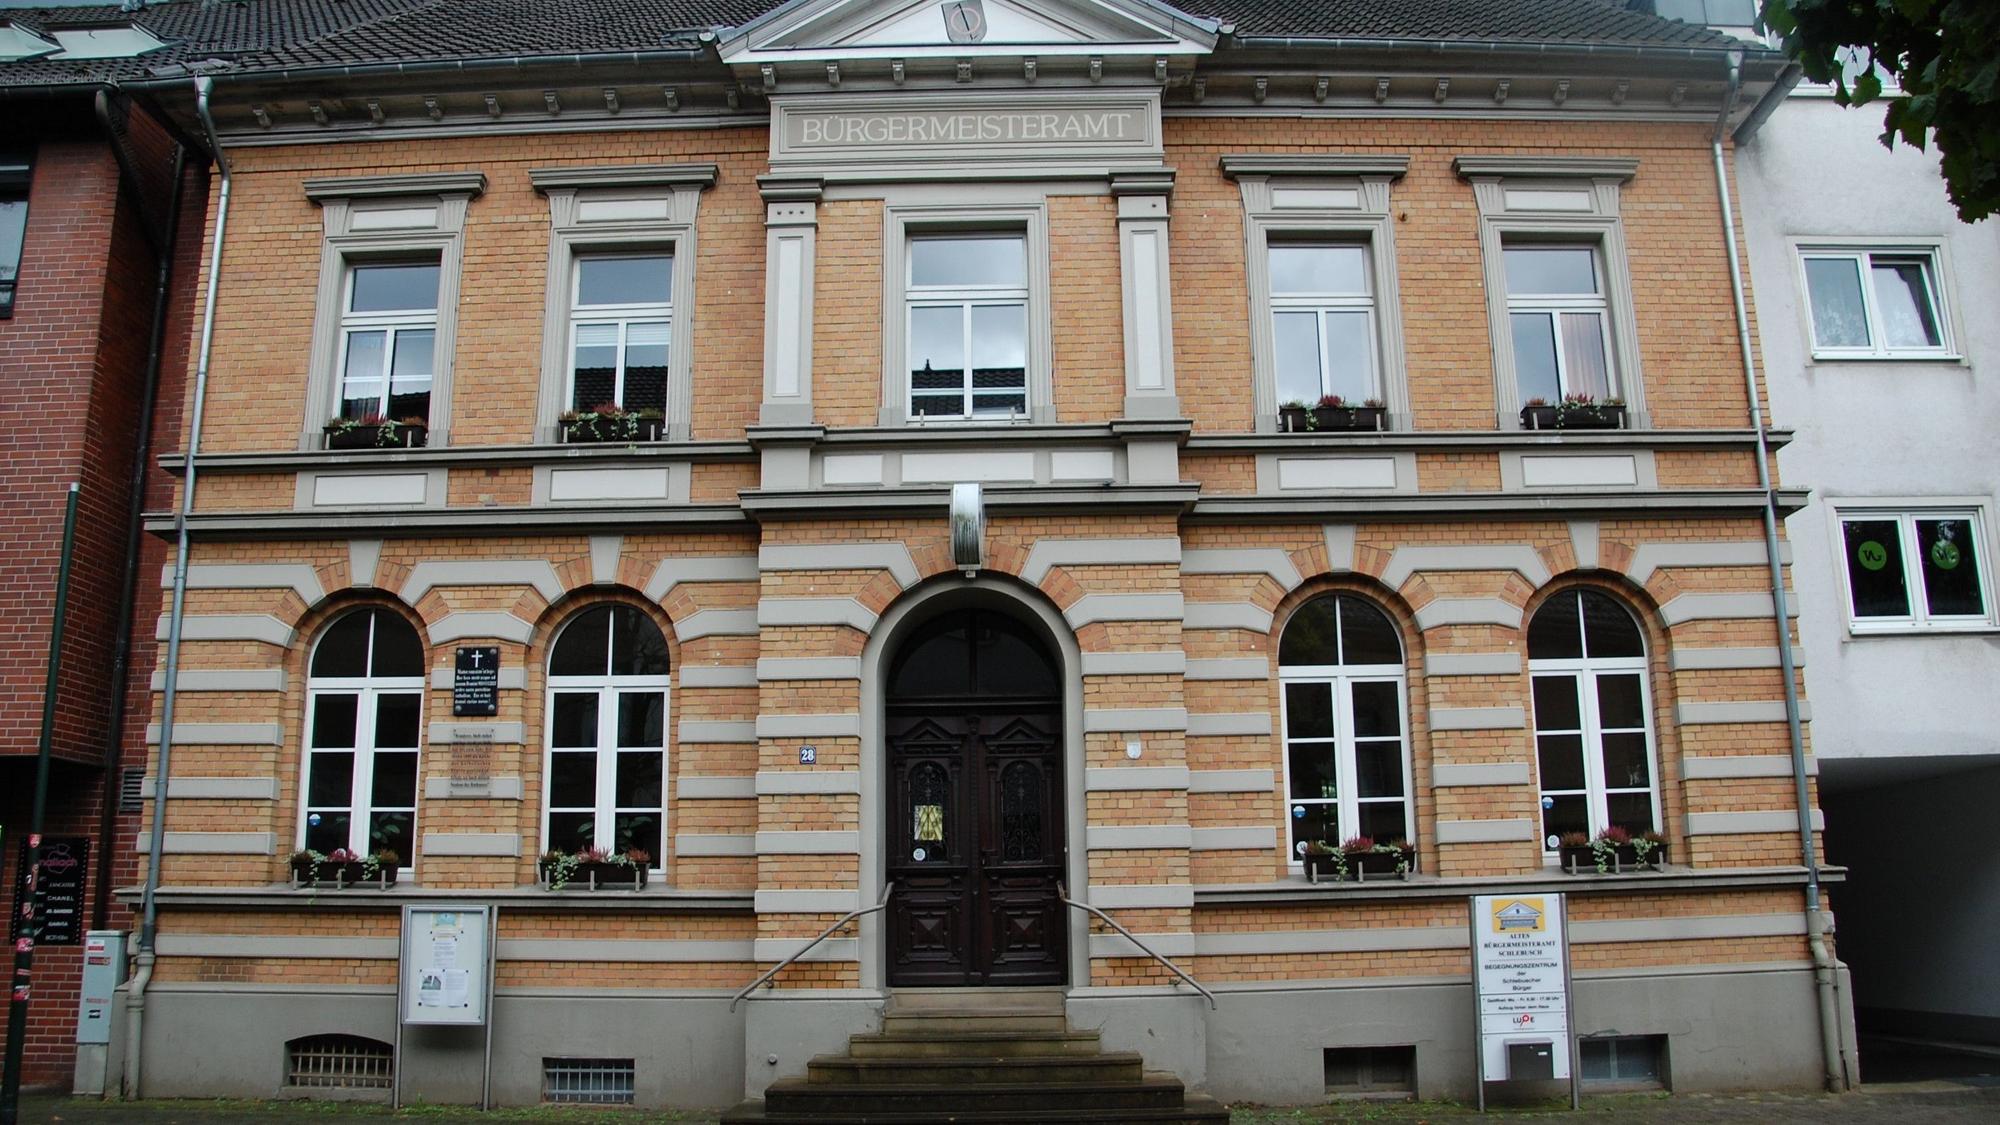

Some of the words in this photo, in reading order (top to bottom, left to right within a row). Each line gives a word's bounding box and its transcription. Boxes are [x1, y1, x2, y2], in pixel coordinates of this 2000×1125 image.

[801, 113, 1131, 143] BÜRGERMEISTERAMT
[801, 749, 814, 761] 28
[1483, 940, 1556, 948] BÜRGERMEISTERAMT
[1484, 962, 1558, 970] BEGEGNUNGSZENTRUM
